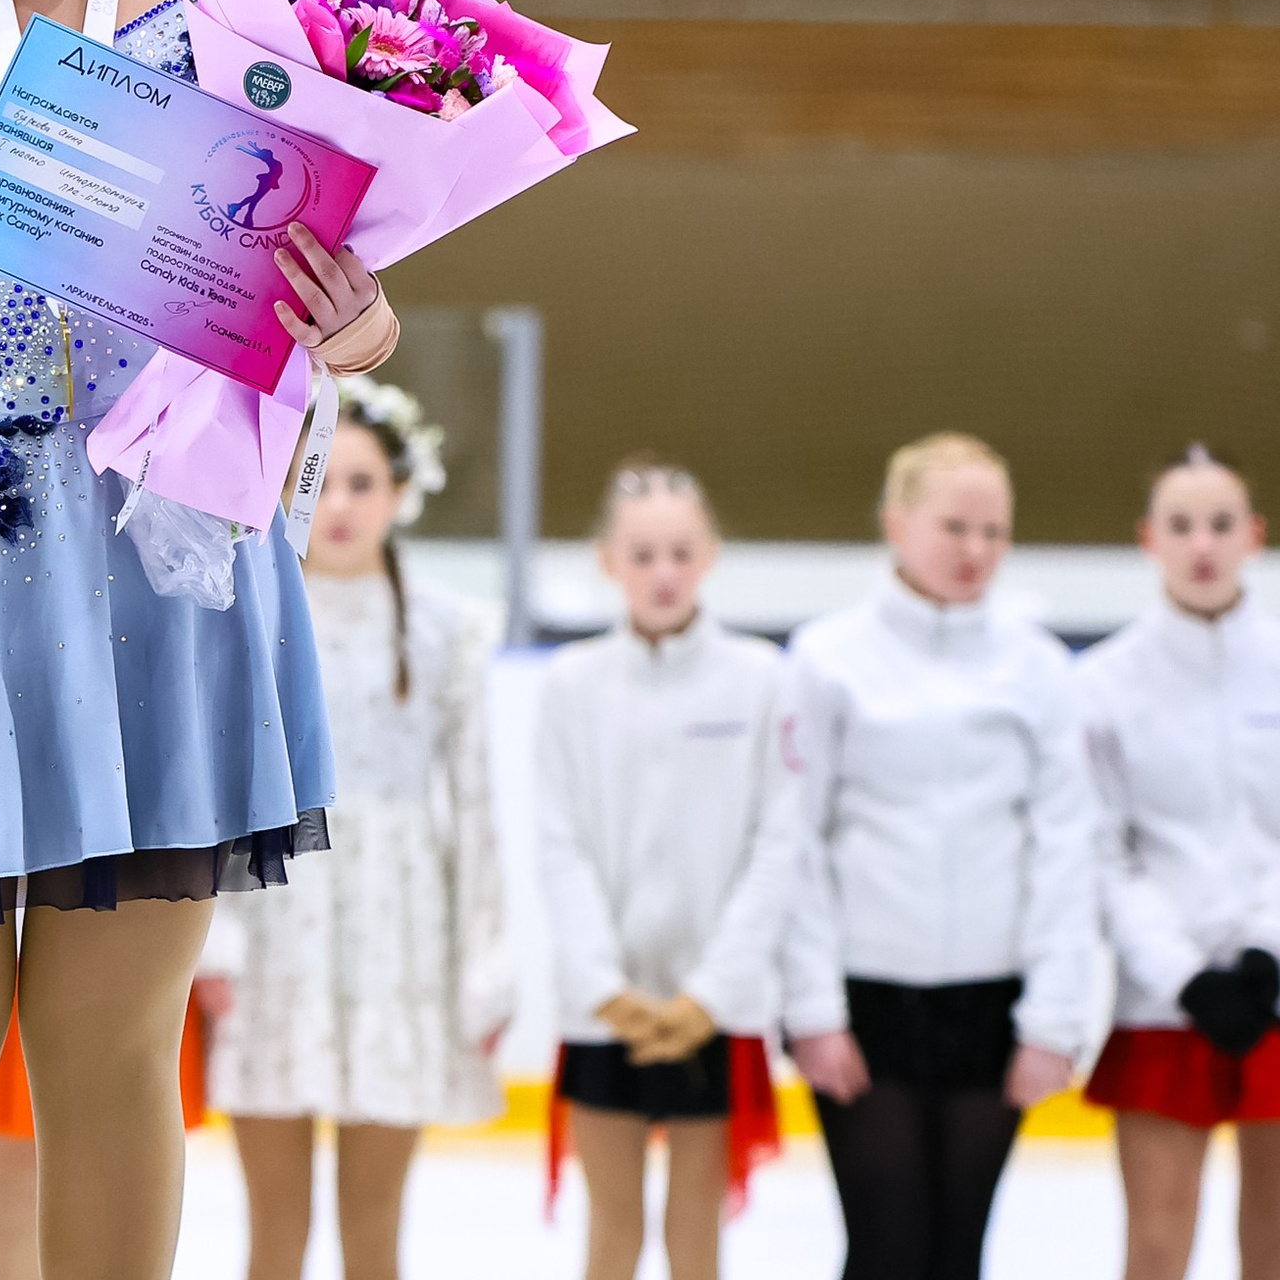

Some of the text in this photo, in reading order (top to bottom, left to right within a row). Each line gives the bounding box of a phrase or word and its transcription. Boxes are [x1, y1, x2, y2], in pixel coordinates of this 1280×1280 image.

[251, 75, 285, 93] КЛЕВЕР
[11, 84, 99, 131] Награждается
[53, 219, 104, 248] катанию
[190, 183, 293, 250] КУБОК CAND
[145, 246, 257, 301] подростковой одежды
[151, 234, 193, 259] магазин
[191, 253, 235, 277] детской
[64, 284, 150, 327] АРХАНГЕЛЬСК 2025
[139, 258, 178, 285] Candy
[176, 274, 200, 294] Kids
[206, 286, 238, 310] Teens
